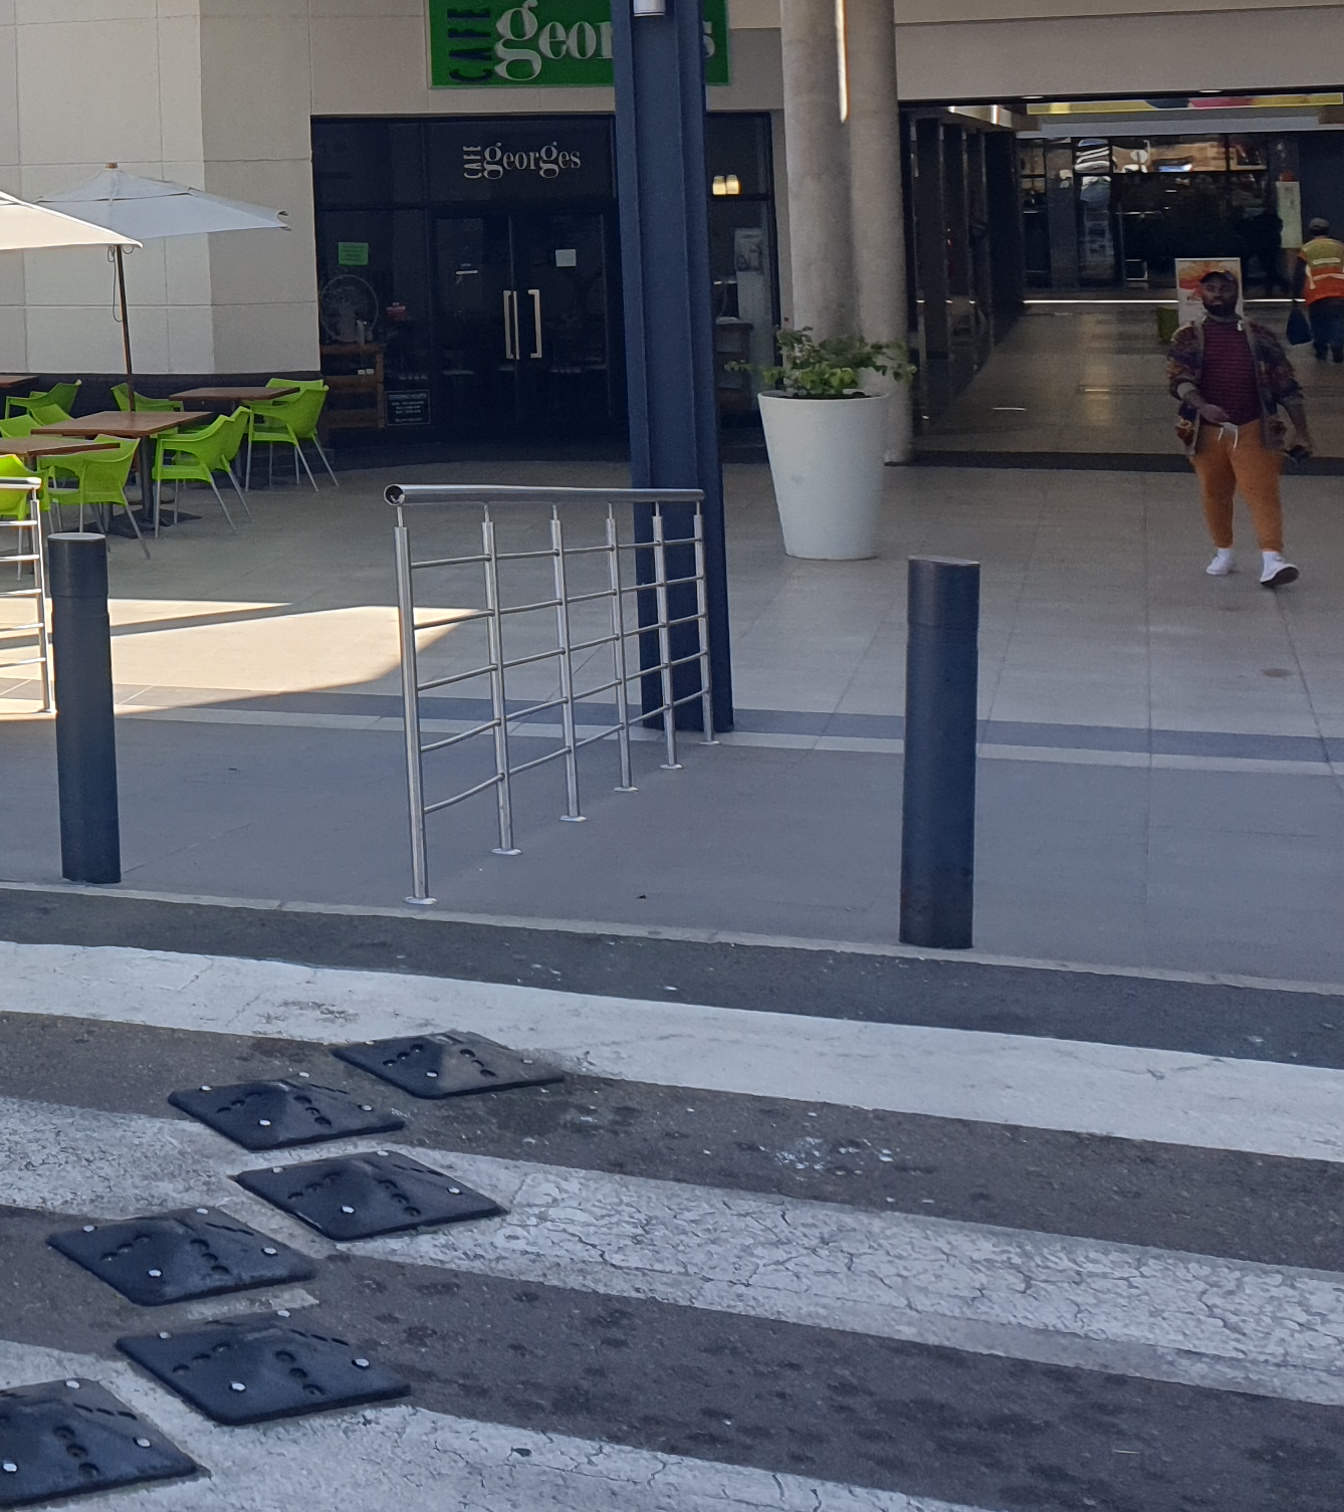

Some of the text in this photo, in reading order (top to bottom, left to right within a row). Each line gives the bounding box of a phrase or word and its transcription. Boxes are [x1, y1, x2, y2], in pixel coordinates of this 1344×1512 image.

[446, 8, 493, 83] CAFE
[462, 145, 483, 180] CAFE
[483, 141, 582, 180] georges
